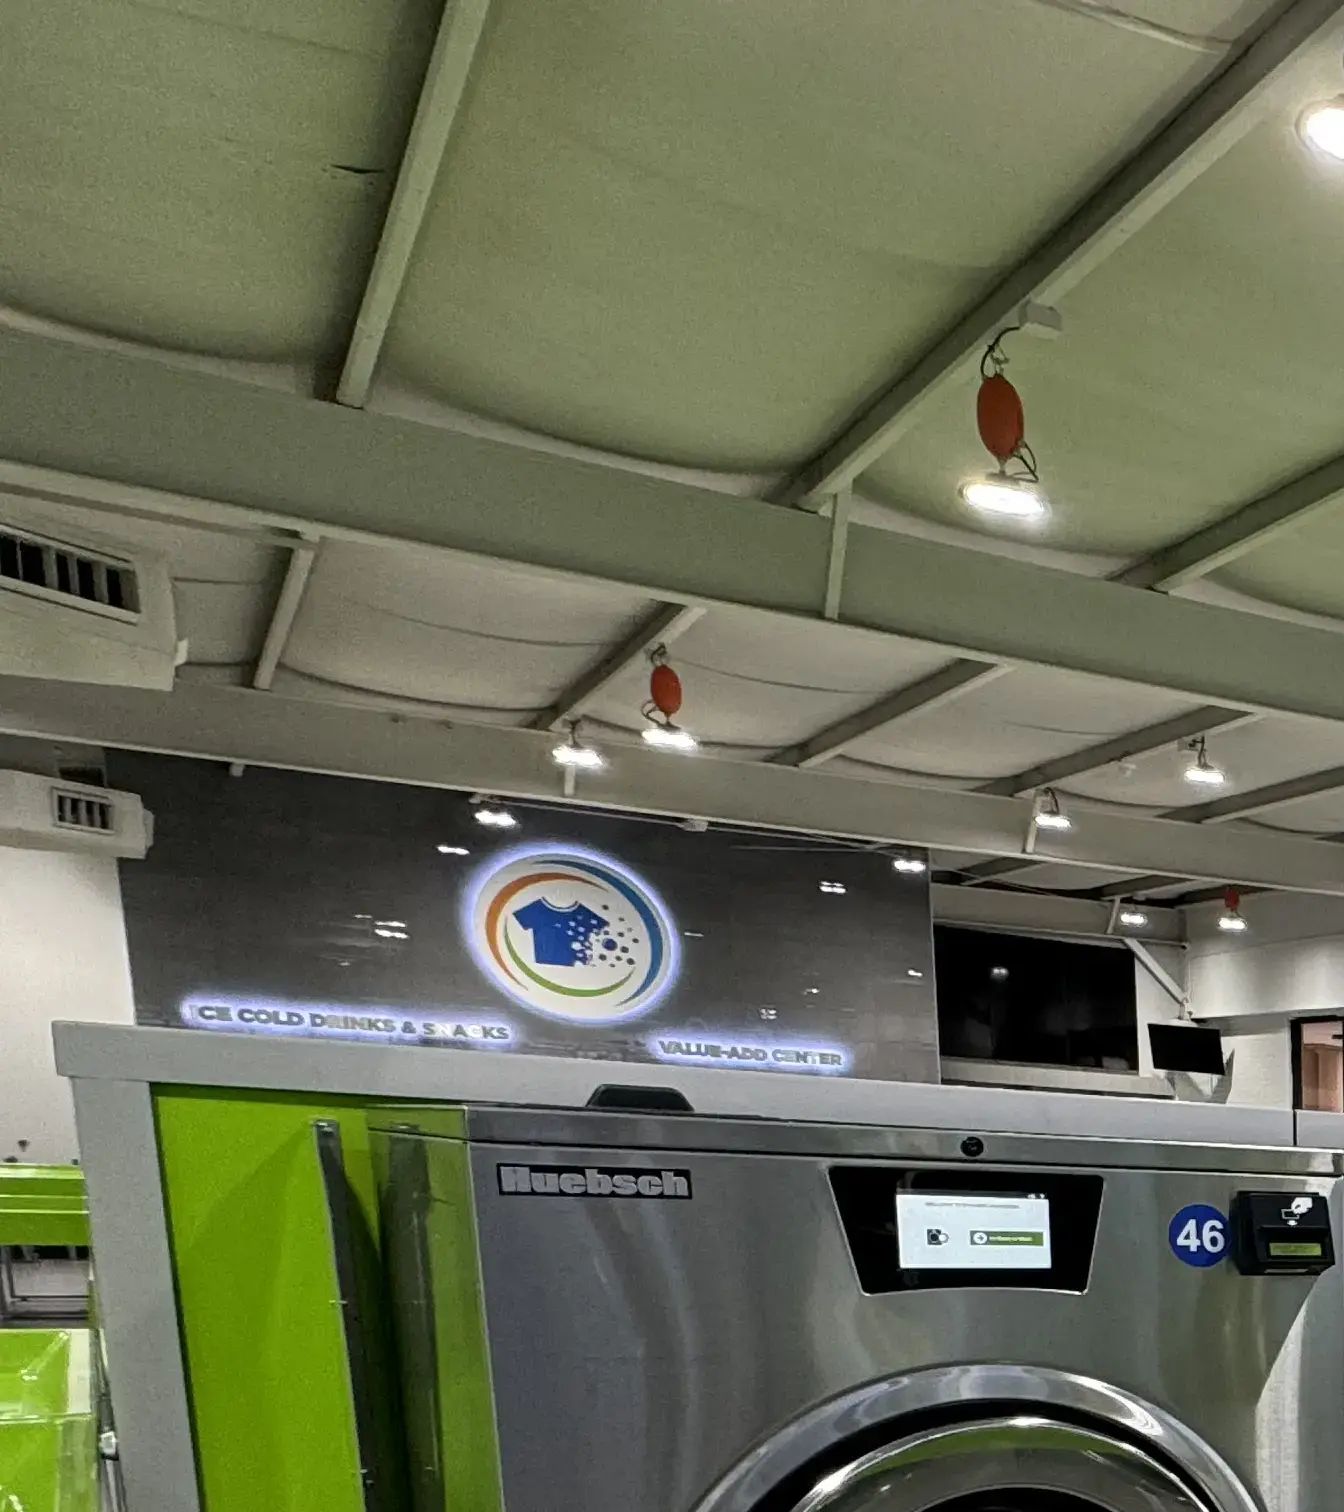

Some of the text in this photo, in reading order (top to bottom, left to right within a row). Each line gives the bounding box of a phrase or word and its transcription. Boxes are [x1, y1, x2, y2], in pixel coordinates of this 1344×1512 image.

[238, 1006, 304, 1026] COLD
[308, 1012, 397, 1033] DRINKS
[400, 1021, 416, 1034] &
[423, 1022, 509, 1040] SNACKS
[772, 1049, 843, 1066] CENTER
[500, 1165, 690, 1197] Huebsch
[1176, 1218, 1226, 1254] 46
